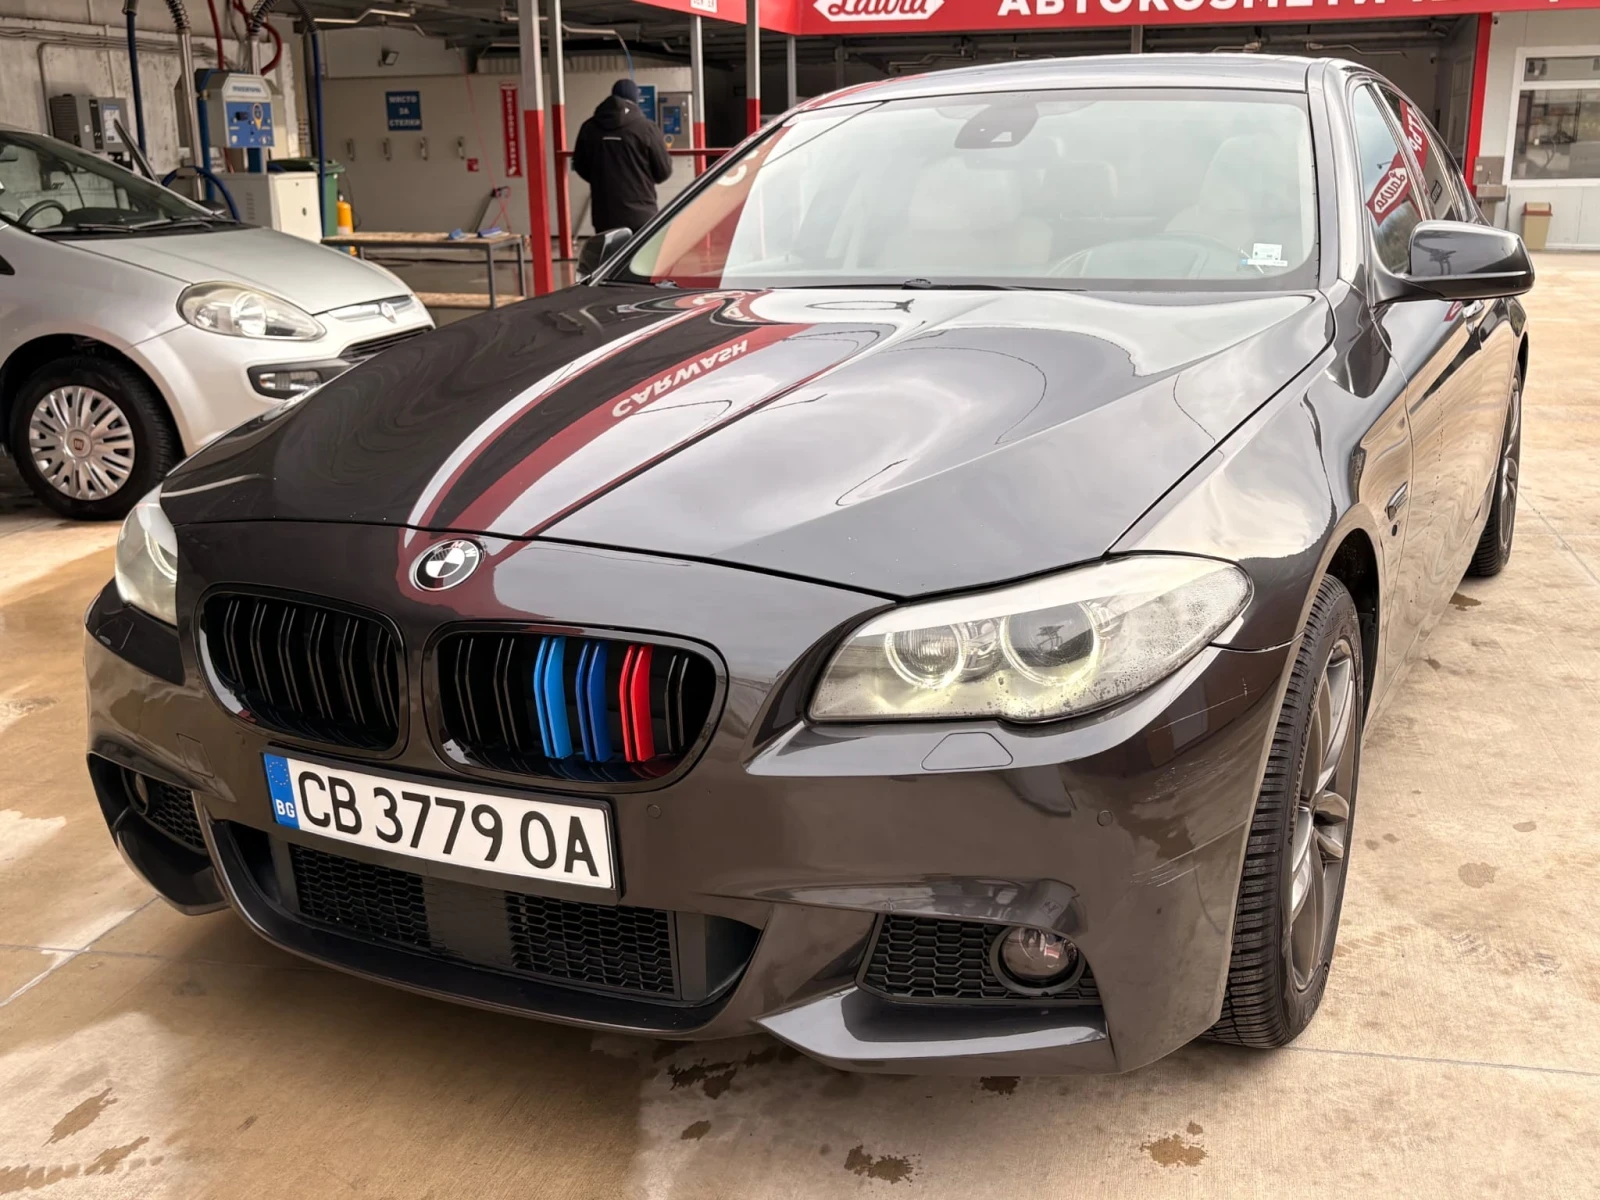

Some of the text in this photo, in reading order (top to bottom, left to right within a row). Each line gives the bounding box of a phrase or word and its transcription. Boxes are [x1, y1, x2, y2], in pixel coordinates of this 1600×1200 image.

[275, 799, 296, 819] BG
[298, 771, 600, 877] CB 3779 OA
